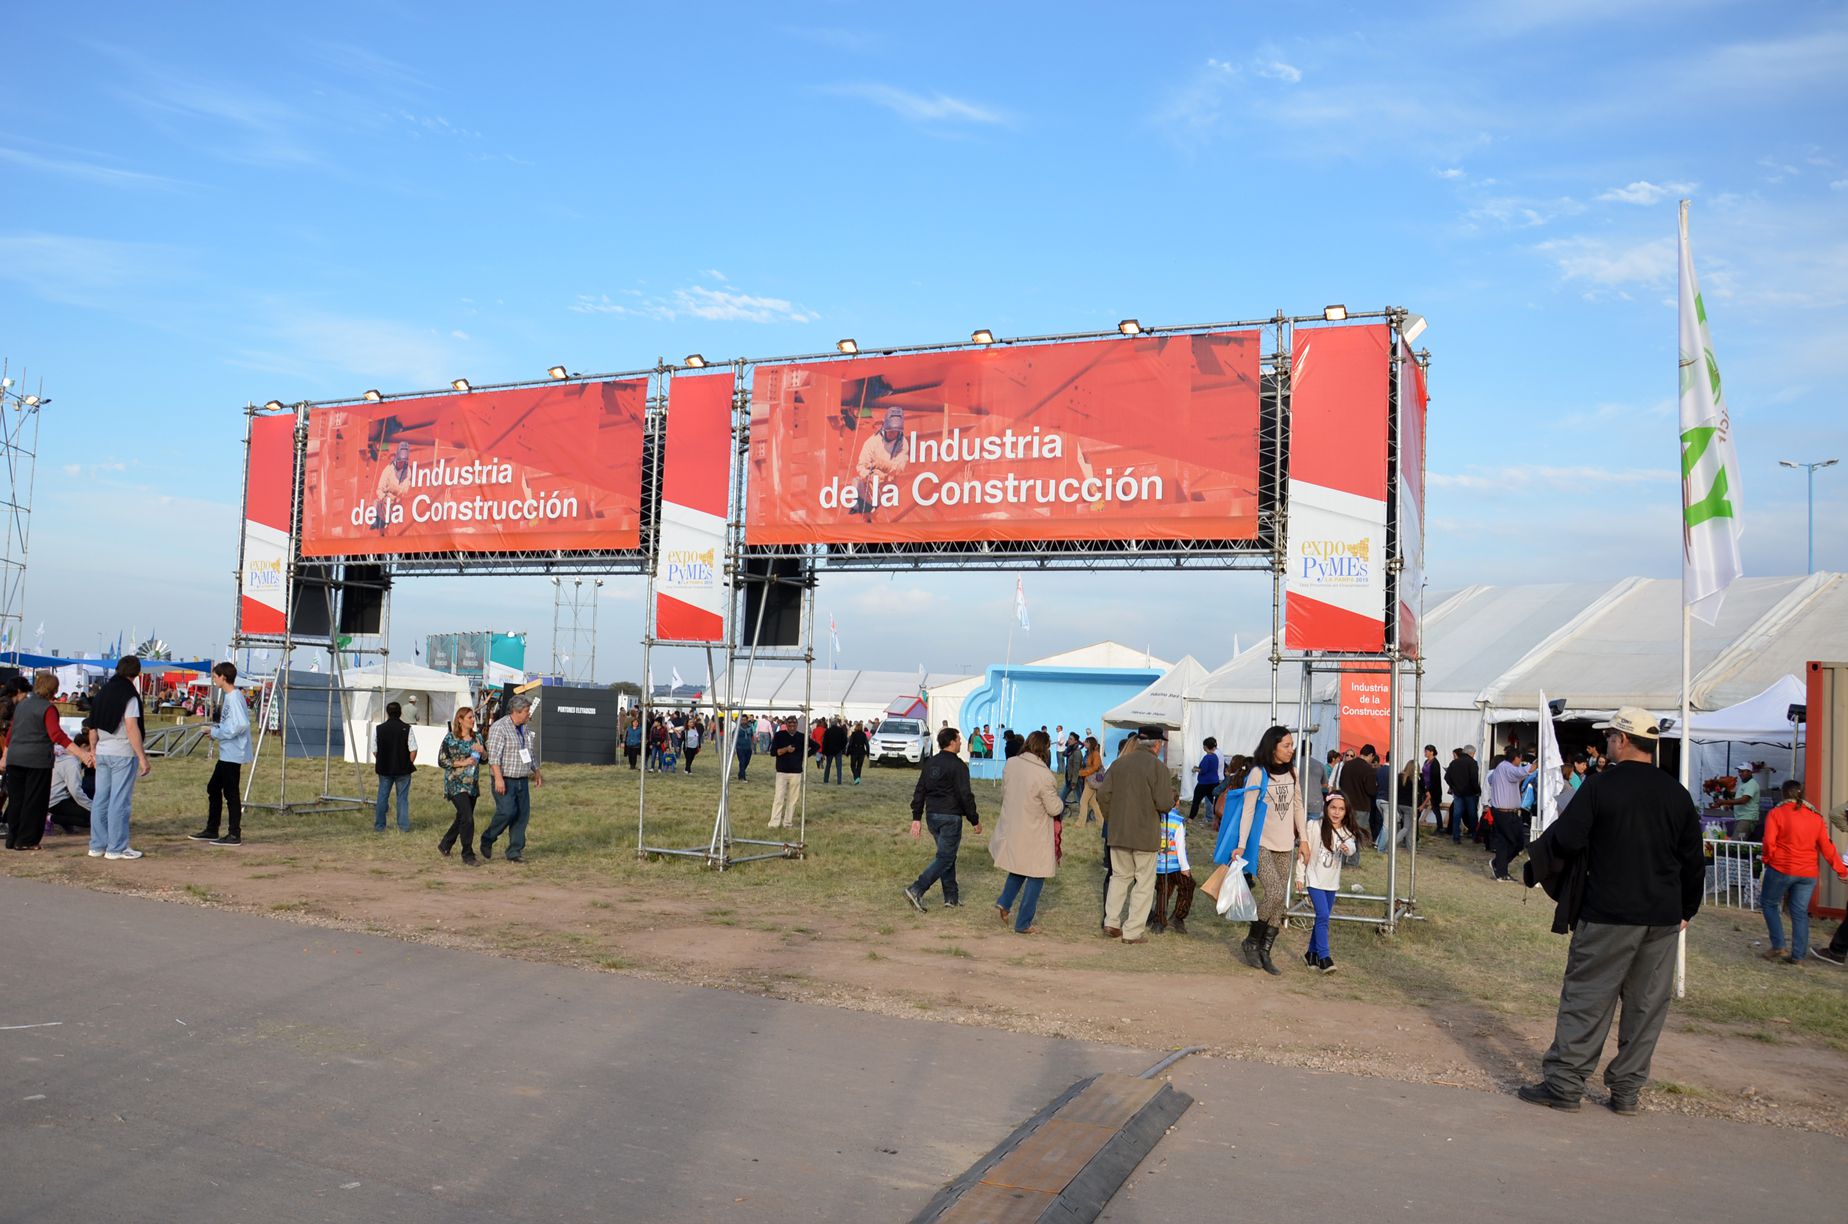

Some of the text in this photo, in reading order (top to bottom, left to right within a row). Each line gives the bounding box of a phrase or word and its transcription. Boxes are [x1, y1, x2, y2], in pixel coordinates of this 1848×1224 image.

[909, 426, 1062, 464] Industria
[410, 457, 512, 488] Industria
[818, 467, 1163, 509] de la Construcción
[350, 490, 578, 526] de la Construcción
[667, 550, 699, 568] expo
[1301, 540, 1346, 561] expo
[668, 563, 713, 585] PyMEs
[1302, 556, 1368, 583] PyMEs
[1351, 682, 1389, 692] Industria
[1359, 694, 1380, 704] de la
[1341, 705, 1391, 717] Construcció
[1275, 785, 1289, 795] LOST
